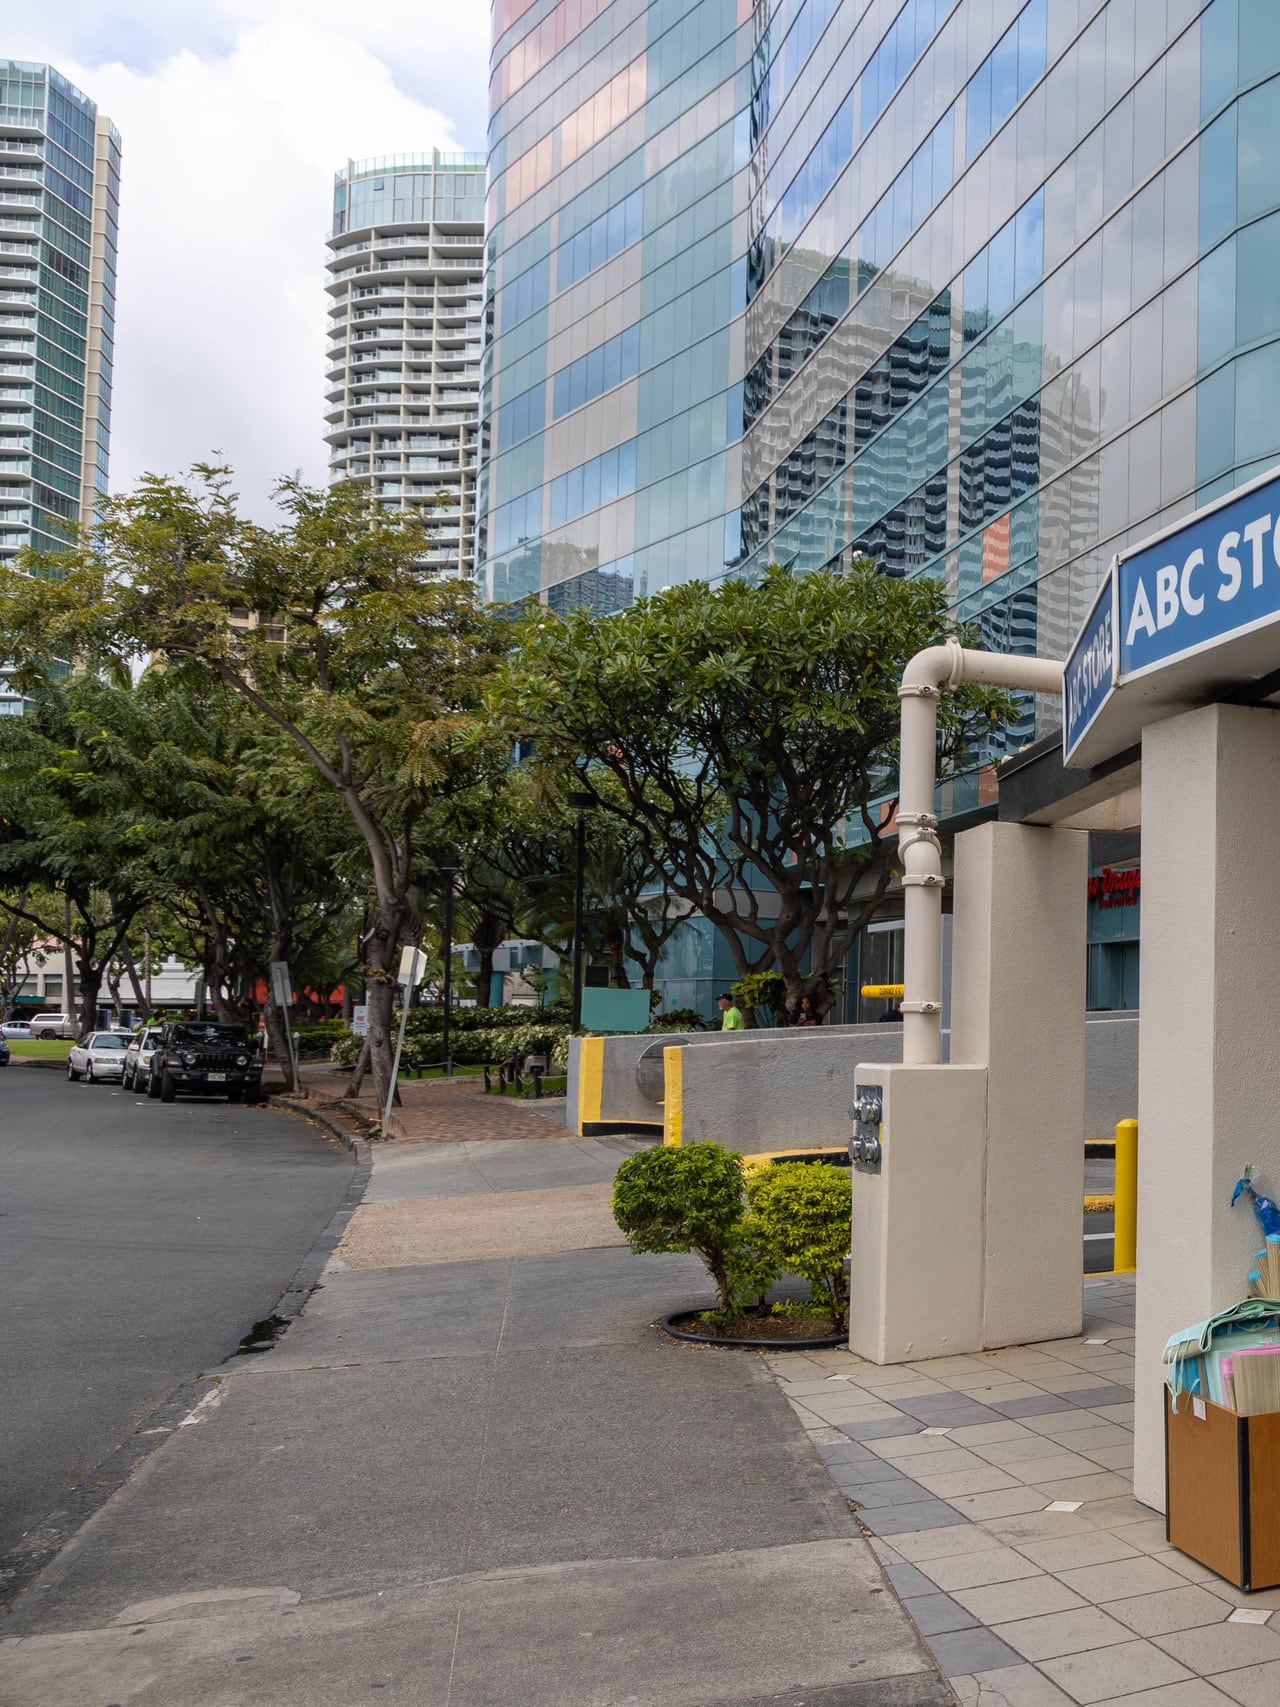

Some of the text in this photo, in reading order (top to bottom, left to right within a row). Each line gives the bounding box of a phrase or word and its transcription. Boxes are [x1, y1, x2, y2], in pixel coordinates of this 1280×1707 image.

[1126, 549, 1205, 646] ABC
[1068, 610, 1113, 735] ABC STORE
